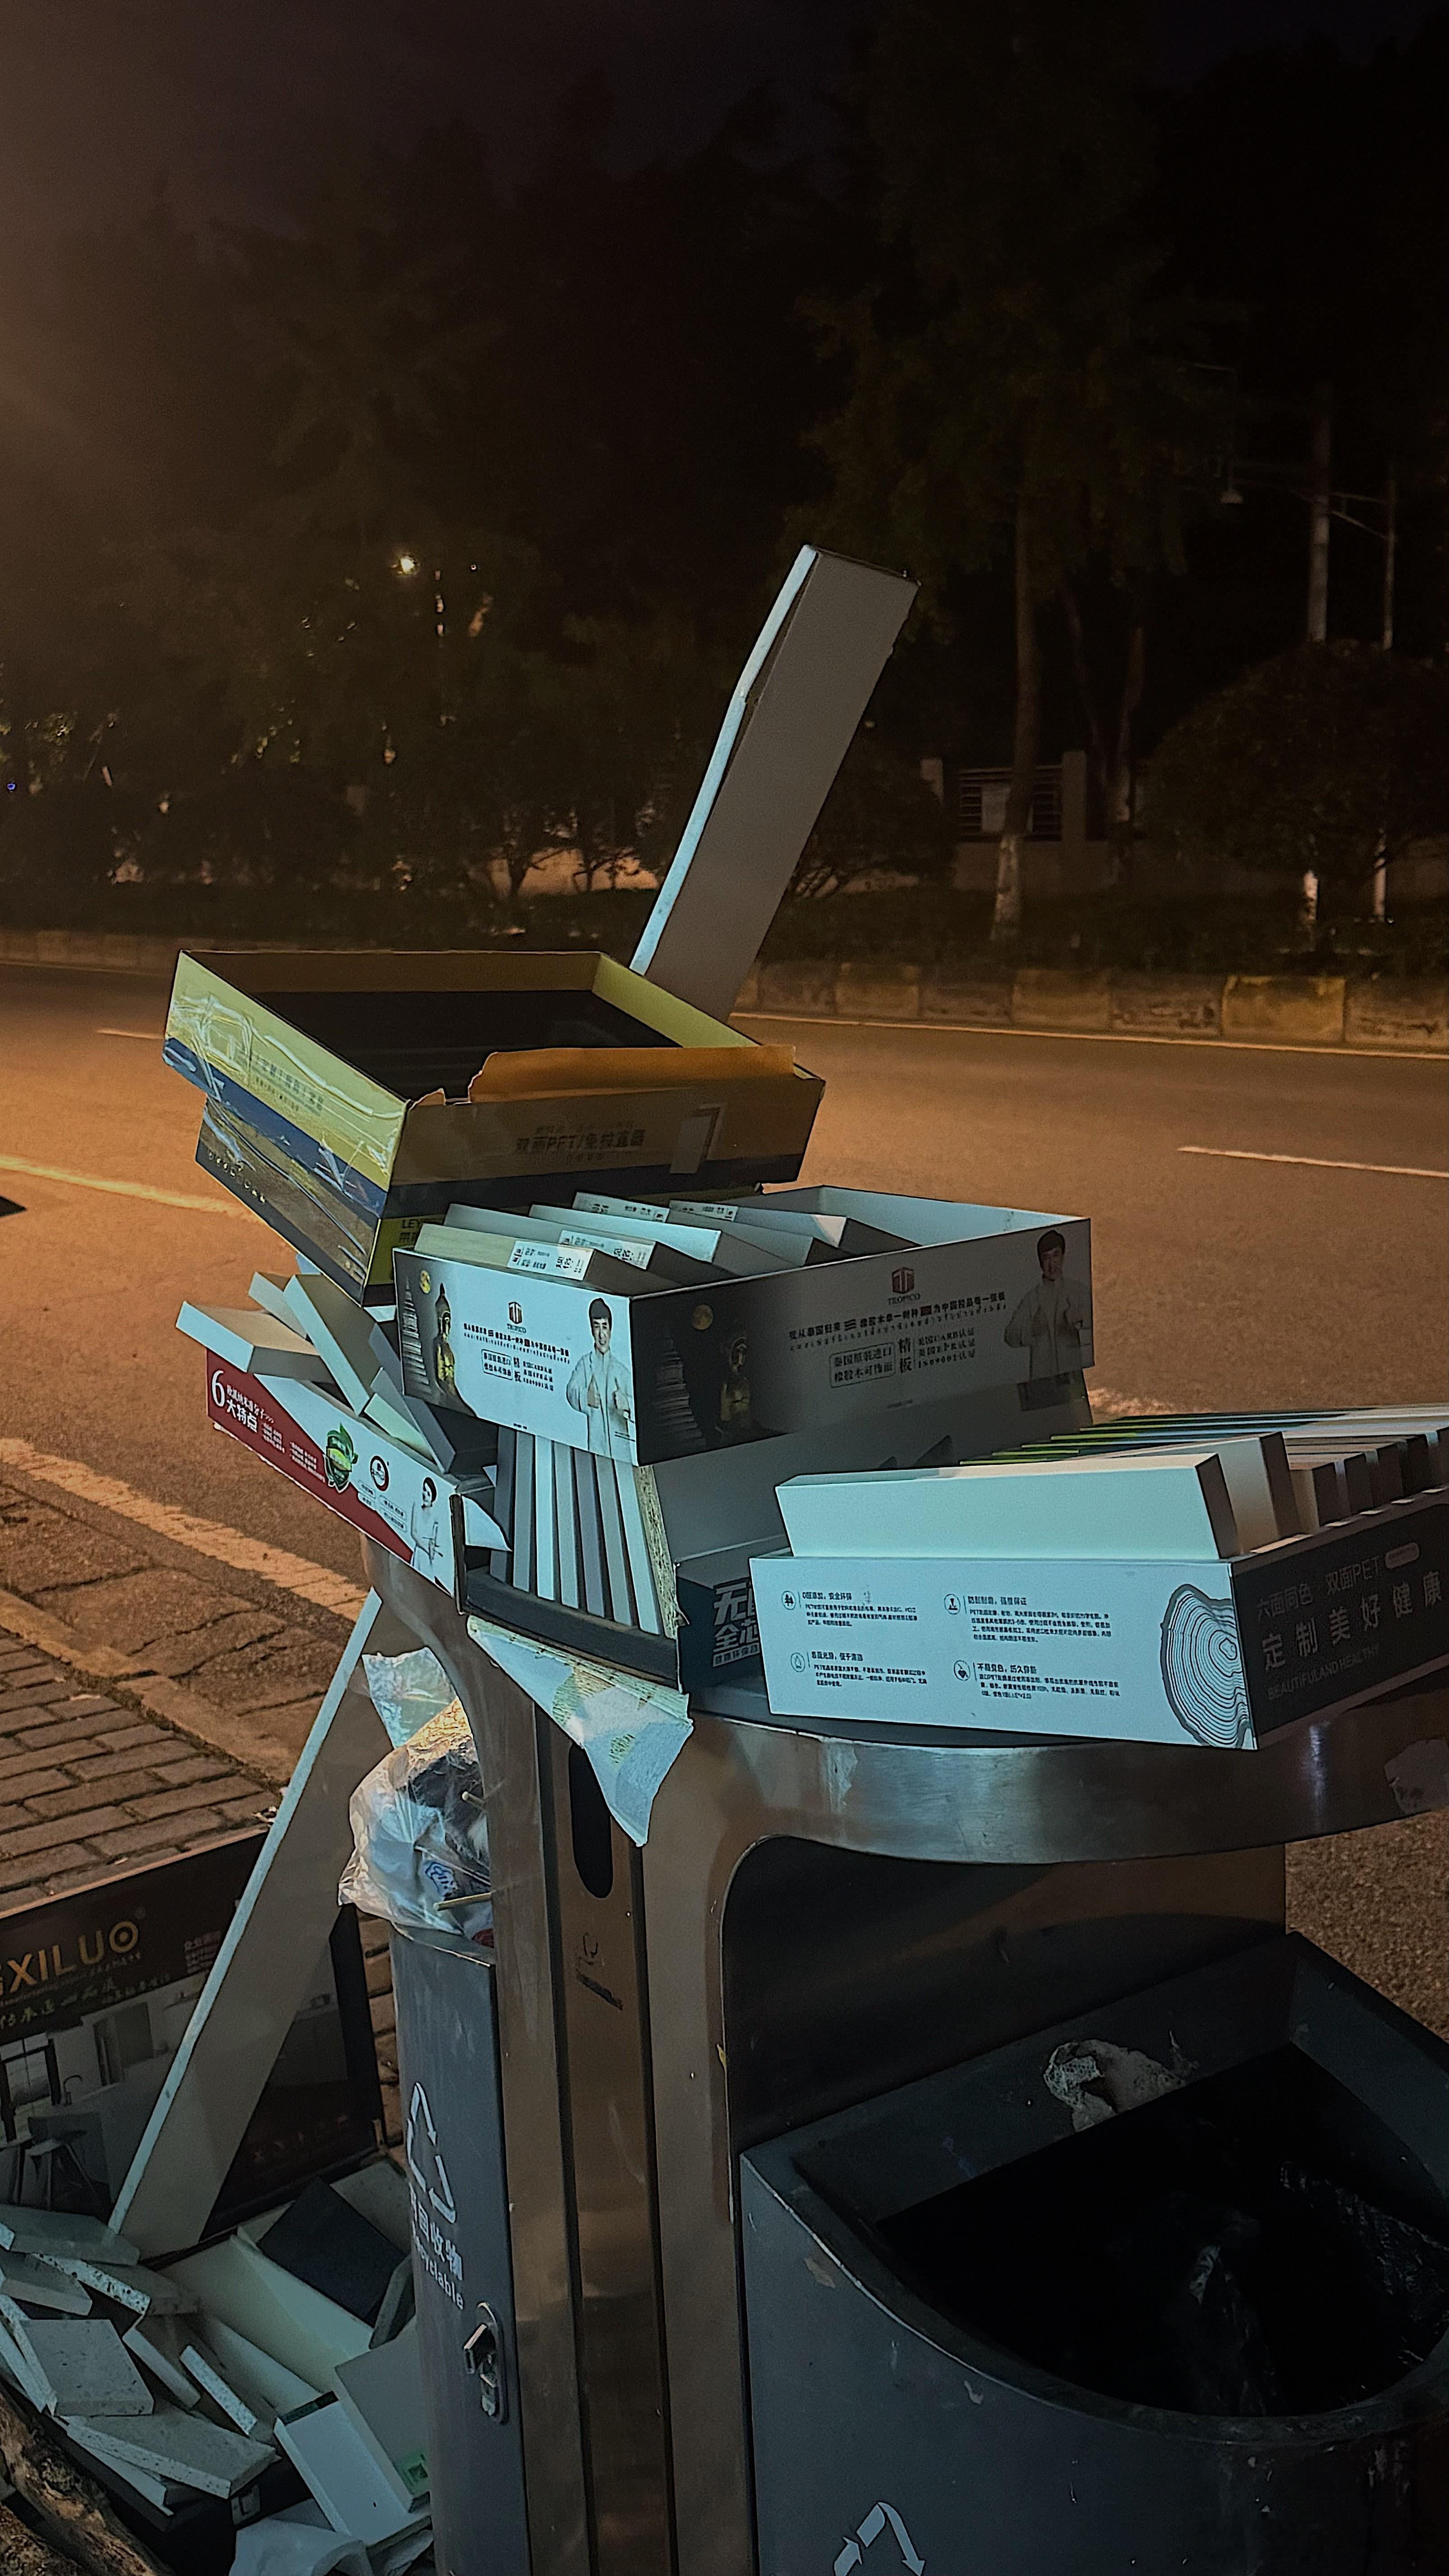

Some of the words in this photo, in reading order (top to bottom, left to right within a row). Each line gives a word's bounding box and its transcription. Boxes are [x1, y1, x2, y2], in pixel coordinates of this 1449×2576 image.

[212, 1370, 225, 1408] 6
[714, 1582, 755, 1626] 无
[1256, 1582, 1313, 1621] 六面同色
[1325, 1556, 1382, 1595] 双面PET
[0, 1920, 138, 1996] XILUO
